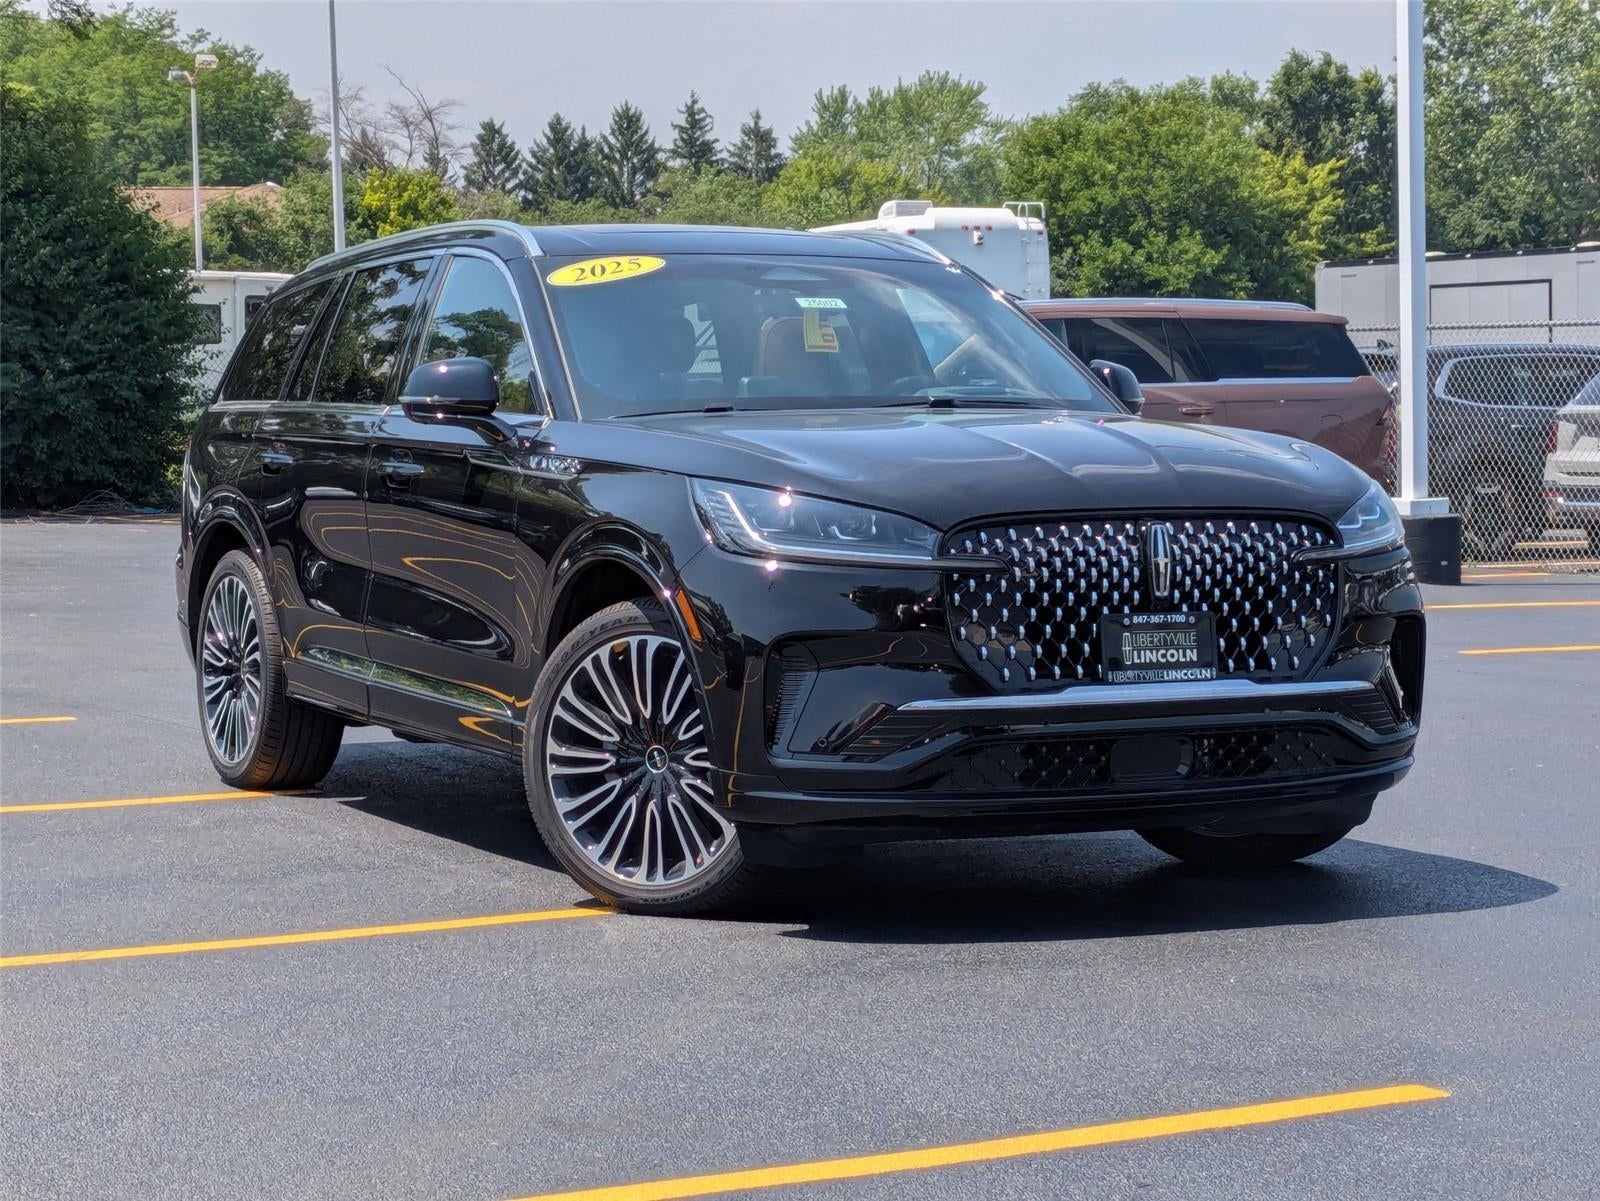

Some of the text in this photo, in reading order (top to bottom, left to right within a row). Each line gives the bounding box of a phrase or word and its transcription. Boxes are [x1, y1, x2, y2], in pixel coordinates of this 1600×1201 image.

[572, 257, 643, 283] 2025
[804, 298, 841, 307] 25002
[1132, 614, 1186, 624] 847-367-1700
[1132, 631, 1198, 647] LIBERTYVILLE
[1133, 648, 1198, 664] LINCOLN
